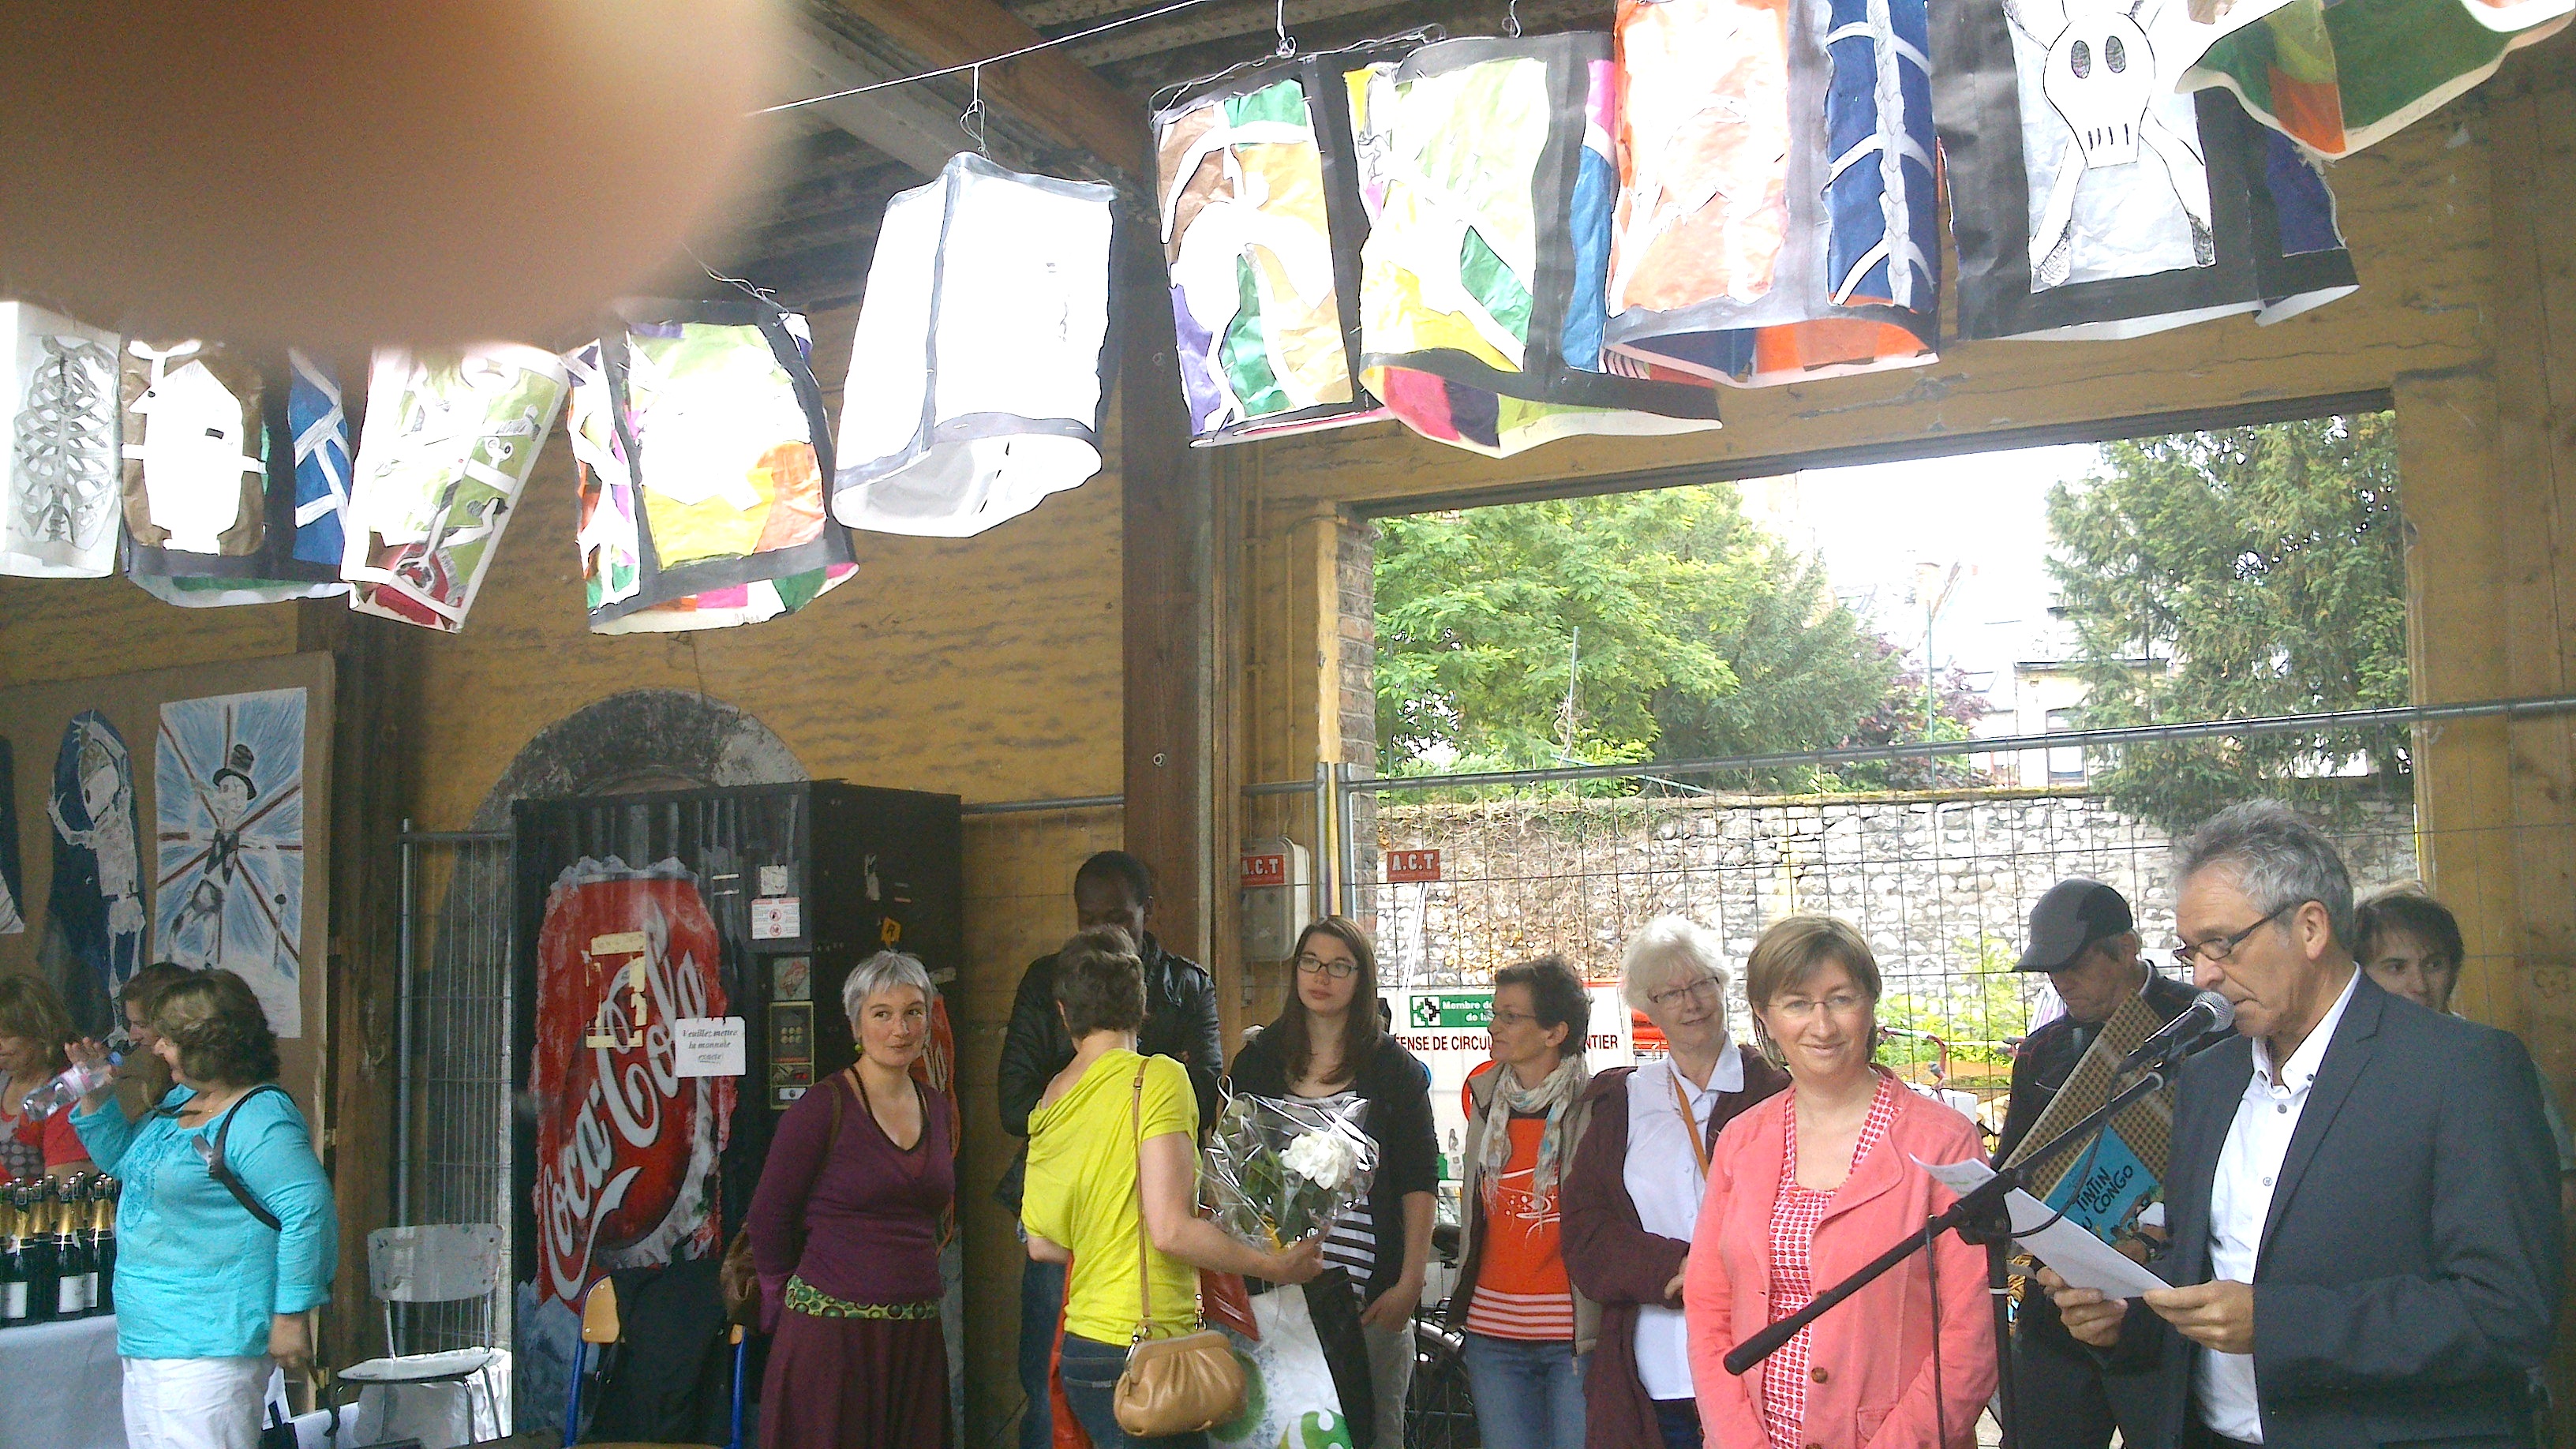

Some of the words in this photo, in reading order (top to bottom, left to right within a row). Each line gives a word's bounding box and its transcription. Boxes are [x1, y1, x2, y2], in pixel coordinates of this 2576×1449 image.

[1442, 1000, 1481, 1010] Membre
[1465, 1012, 1478, 1022] de
[1396, 1035, 1430, 1051] FENSE
[1432, 1035, 1448, 1051] DE
[2076, 1166, 2112, 1213] TINTIN
[2092, 1164, 2134, 1215] CONGO
